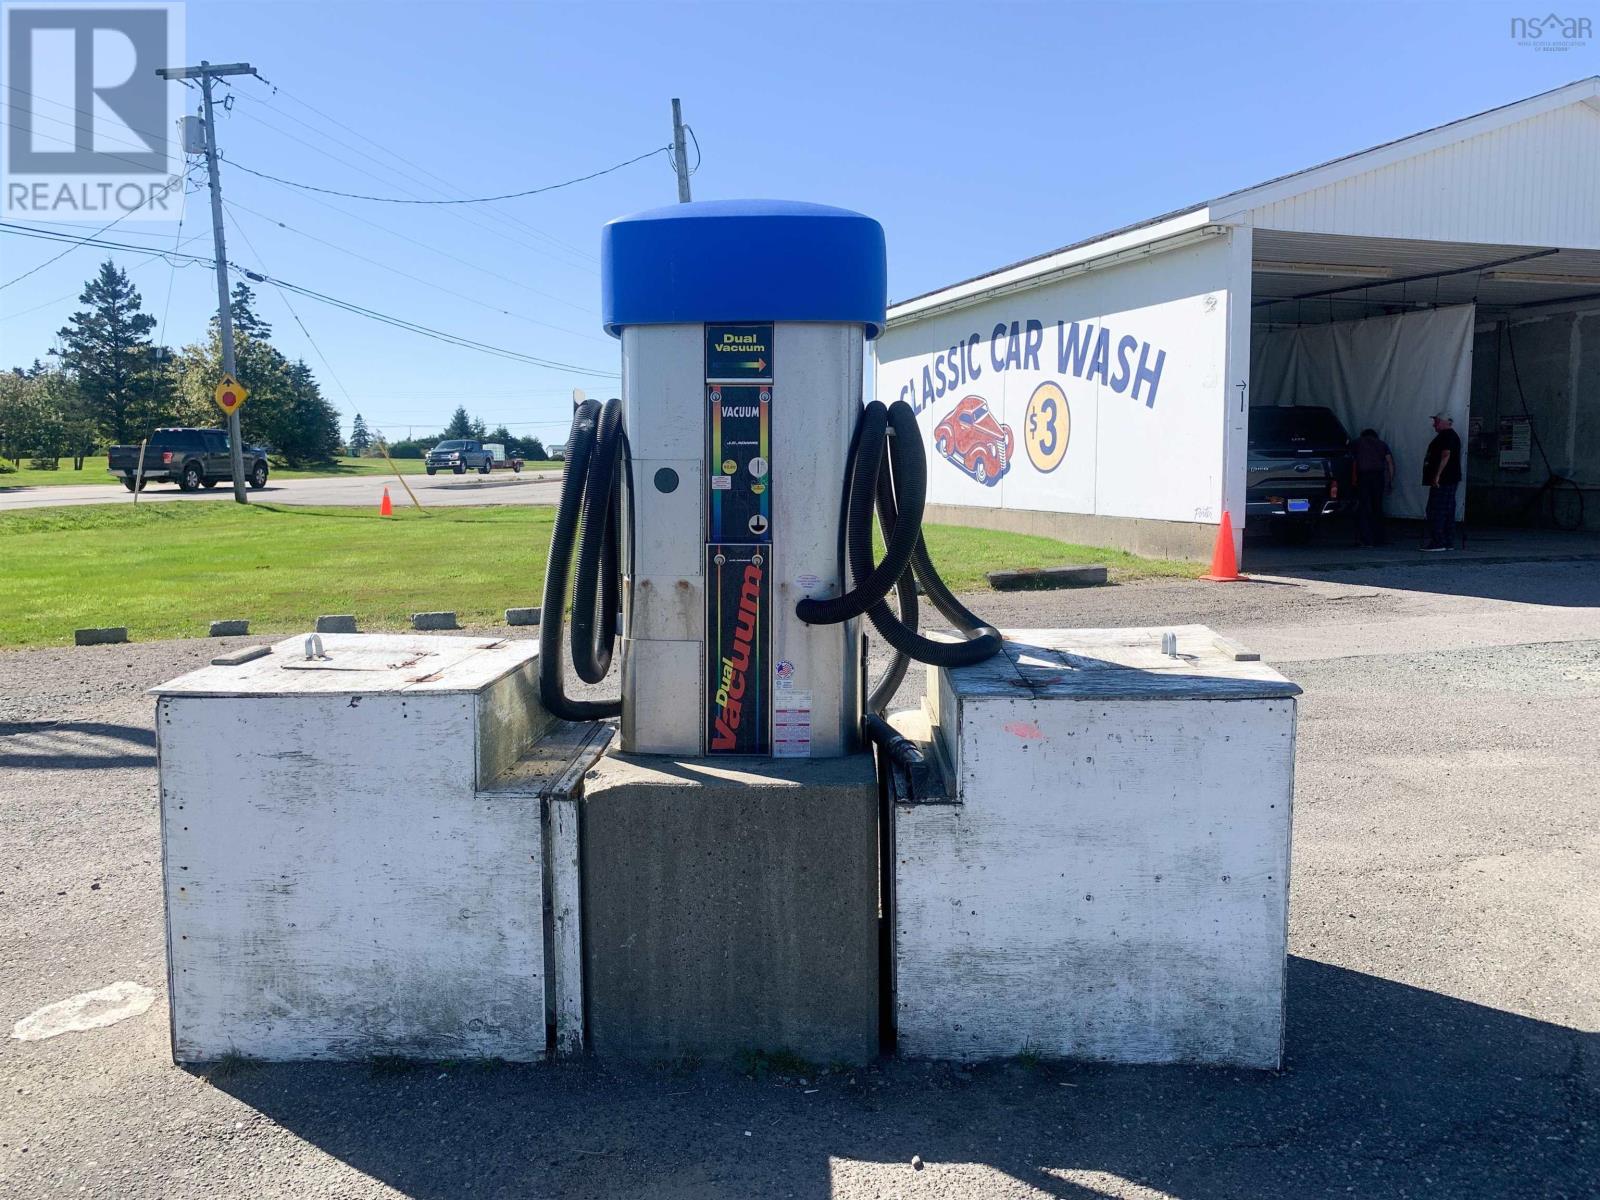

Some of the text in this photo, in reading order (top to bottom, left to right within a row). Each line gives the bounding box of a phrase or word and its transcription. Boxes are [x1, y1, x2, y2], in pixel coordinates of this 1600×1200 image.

[714, 343, 765, 352] Vacuum
[723, 334, 757, 343] Dual
[990, 319, 1044, 373] CAR
[1057, 320, 1167, 409] WASH
[721, 406, 760, 418] VACUUM
[1030, 398, 1057, 455] $3
[711, 565, 763, 750] Vacuum
[715, 656, 734, 708] Dual
